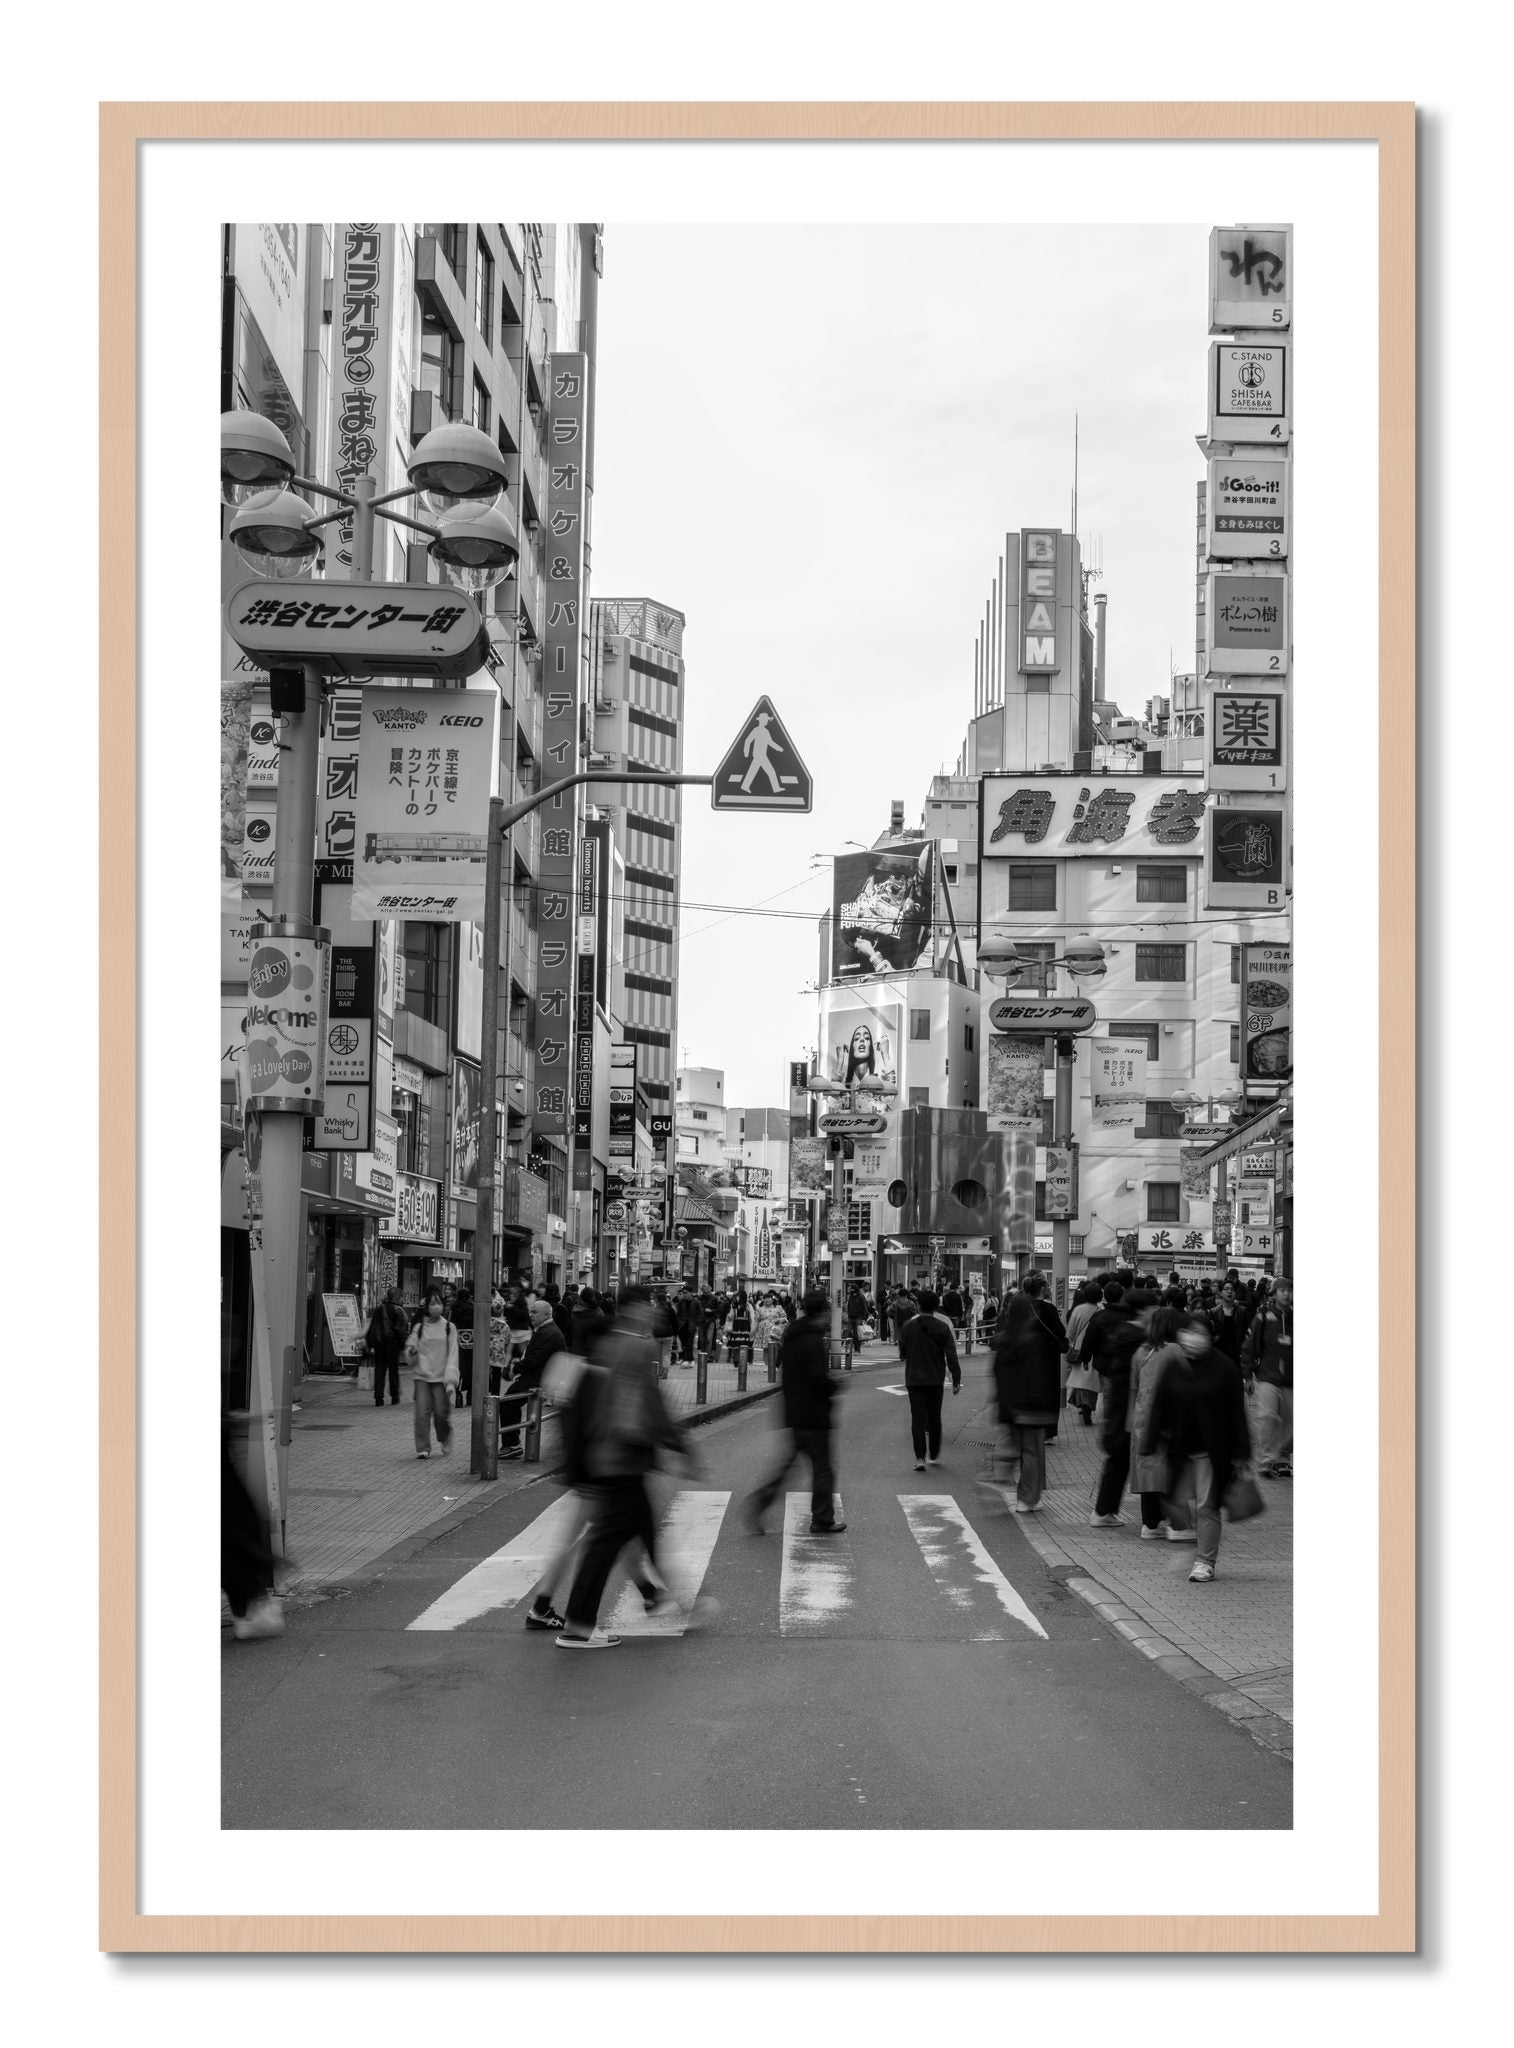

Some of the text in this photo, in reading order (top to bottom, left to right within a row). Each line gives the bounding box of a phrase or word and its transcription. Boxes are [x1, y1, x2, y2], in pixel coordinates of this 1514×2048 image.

[343, 232, 381, 357] カラオケ
[1271, 308, 1283, 323] 5
[1231, 352, 1273, 361] C.STAND
[1231, 389, 1272, 399] SHISHA
[1231, 399, 1272, 407] CAFE&BAR
[1270, 424, 1282, 438] 4
[1229, 478, 1280, 493] Goo-it!
[1219, 519, 1281, 530] 全身もみほぐし
[1269, 539, 1281, 555] 3
[1025, 534, 1056, 666] BEAM
[239, 599, 467, 635] 渋谷センター街
[1269, 655, 1280, 670] 2
[384, 722, 417, 730] KANTO
[439, 714, 485, 728] KEIO
[1222, 700, 1269, 747] 薬
[1217, 749, 1275, 762] マツモトキヨシ
[405, 747, 422, 816] カントーの
[423, 747, 441, 816] ポケパーク
[443, 748, 460, 803] 京王線で
[1268, 772, 1277, 787] 1
[990, 787, 1208, 844] 角海老
[1217, 823, 1273, 868] 一蘭
[583, 842, 593, 875] kimono
[376, 896, 459, 908] 渋谷センター街
[1267, 889, 1279, 905] B
[250, 959, 288, 991] Enjoy
[1249, 962, 1288, 973] 四川料理
[537, 892, 568, 1116] カラオケ館
[247, 1005, 318, 1028] Welcome
[996, 1006, 1090, 1019] 渋谷センター街
[1247, 1014, 1274, 1033] 6F
[262, 1058, 291, 1076] Lovely
[292, 1059, 310, 1072] Day!
[323, 1126, 342, 1134] Bank
[324, 1118, 355, 1128] Whisky
[652, 1121, 671, 1131] GU
[760, 1228, 769, 1267] BEER
[1151, 1229, 1205, 1250] 兆楽
